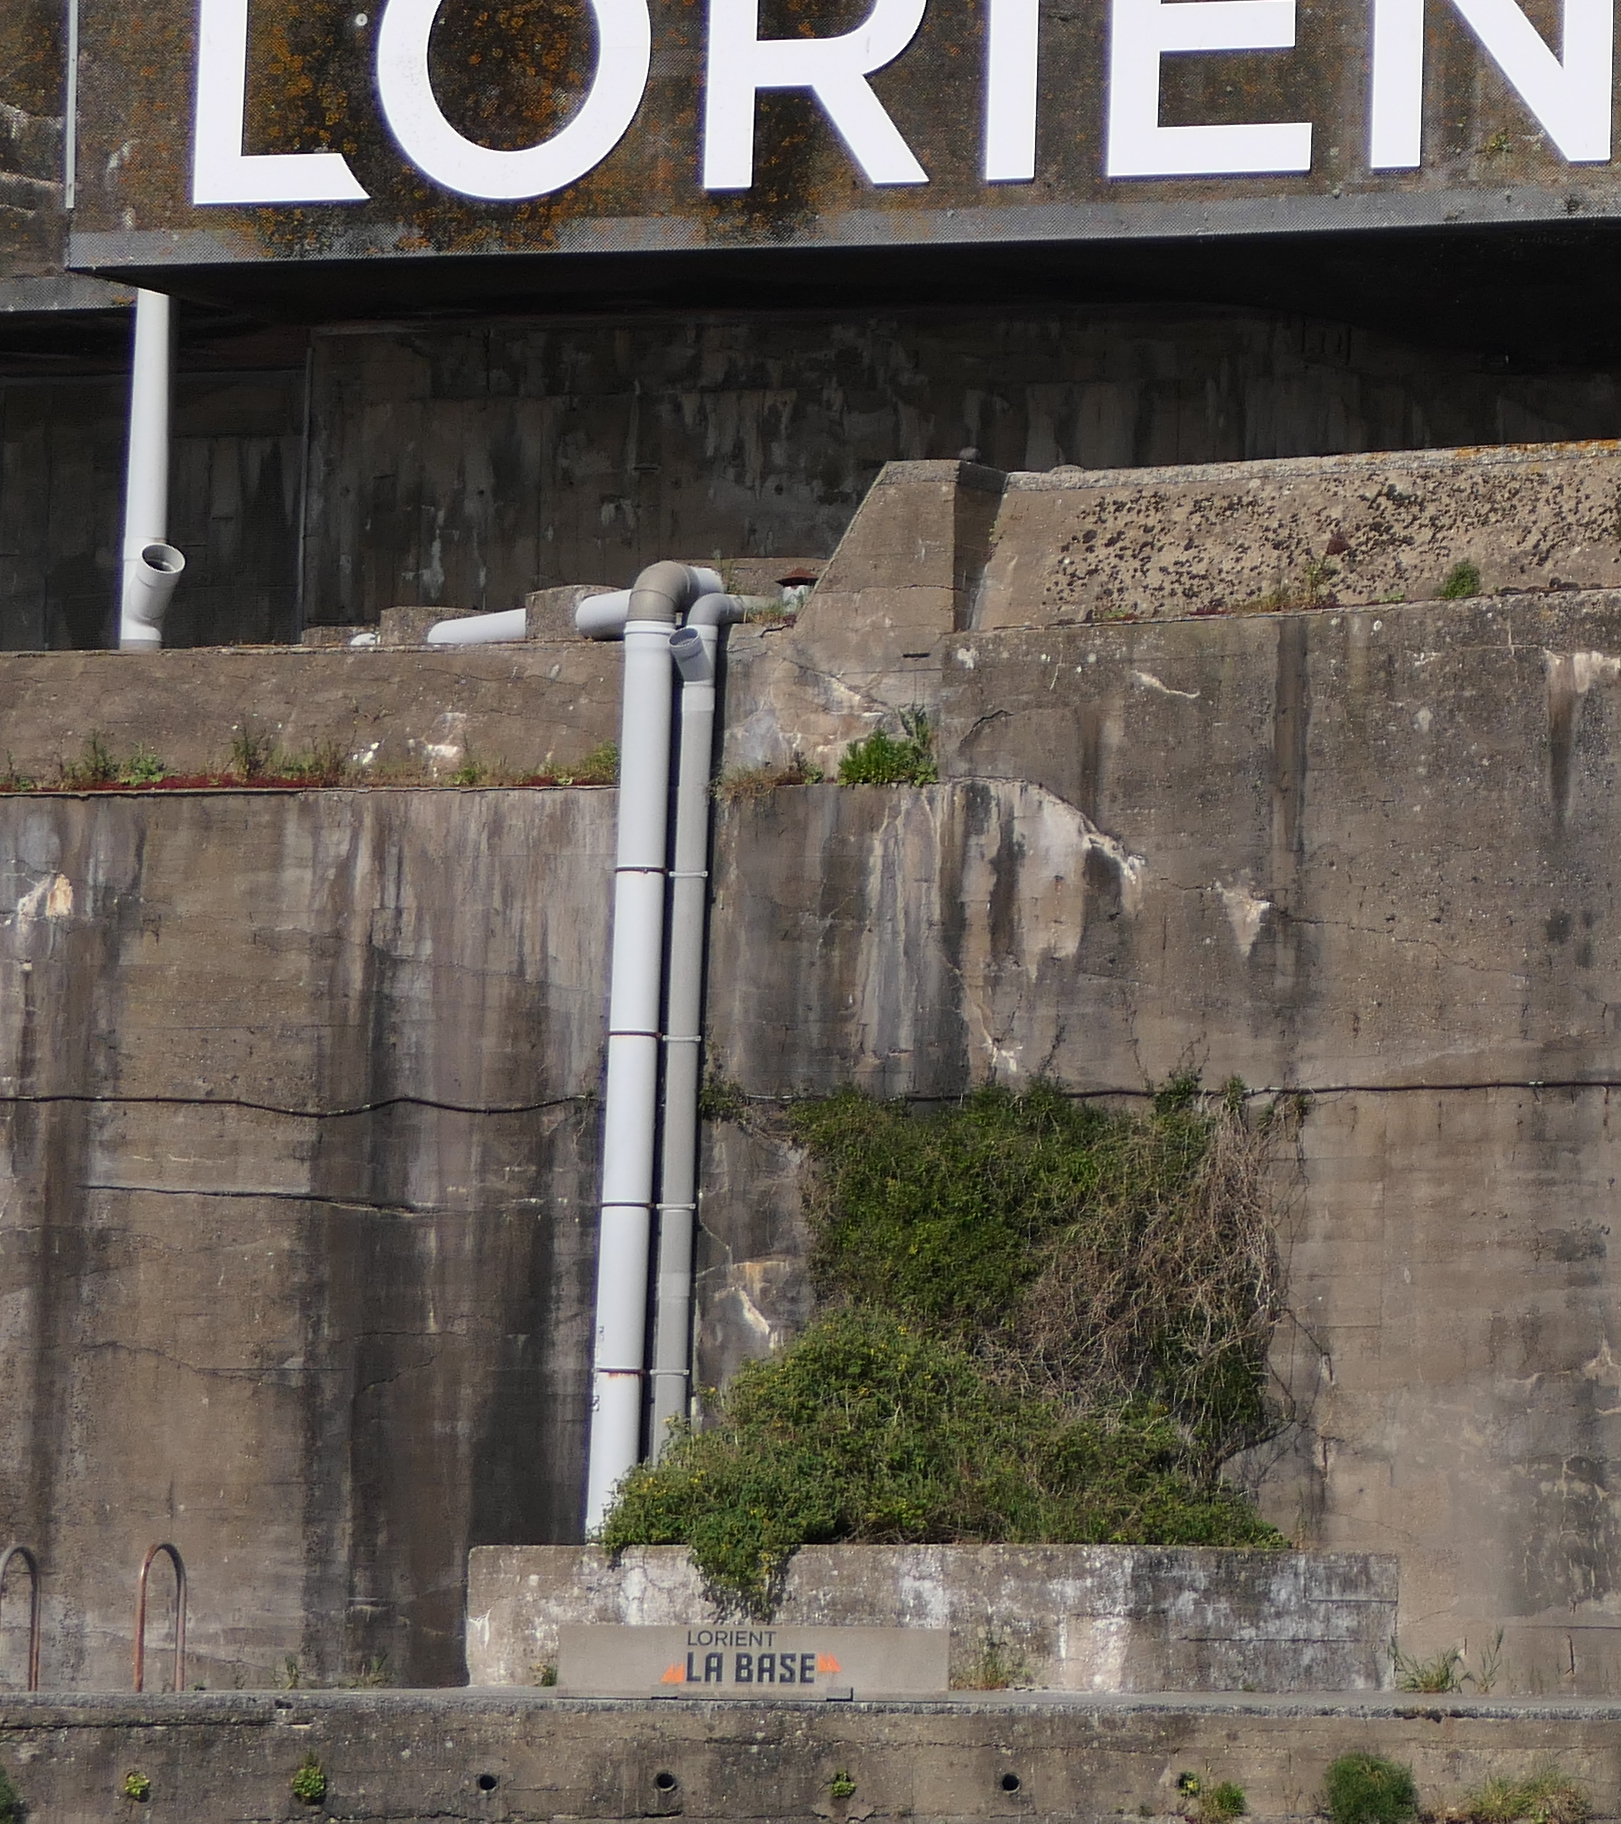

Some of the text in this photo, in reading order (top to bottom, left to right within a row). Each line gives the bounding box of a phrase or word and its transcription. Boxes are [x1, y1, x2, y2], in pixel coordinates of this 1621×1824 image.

[687, 1630, 776, 1647] LORIENT
[687, 1652, 815, 1684] LA BASE
